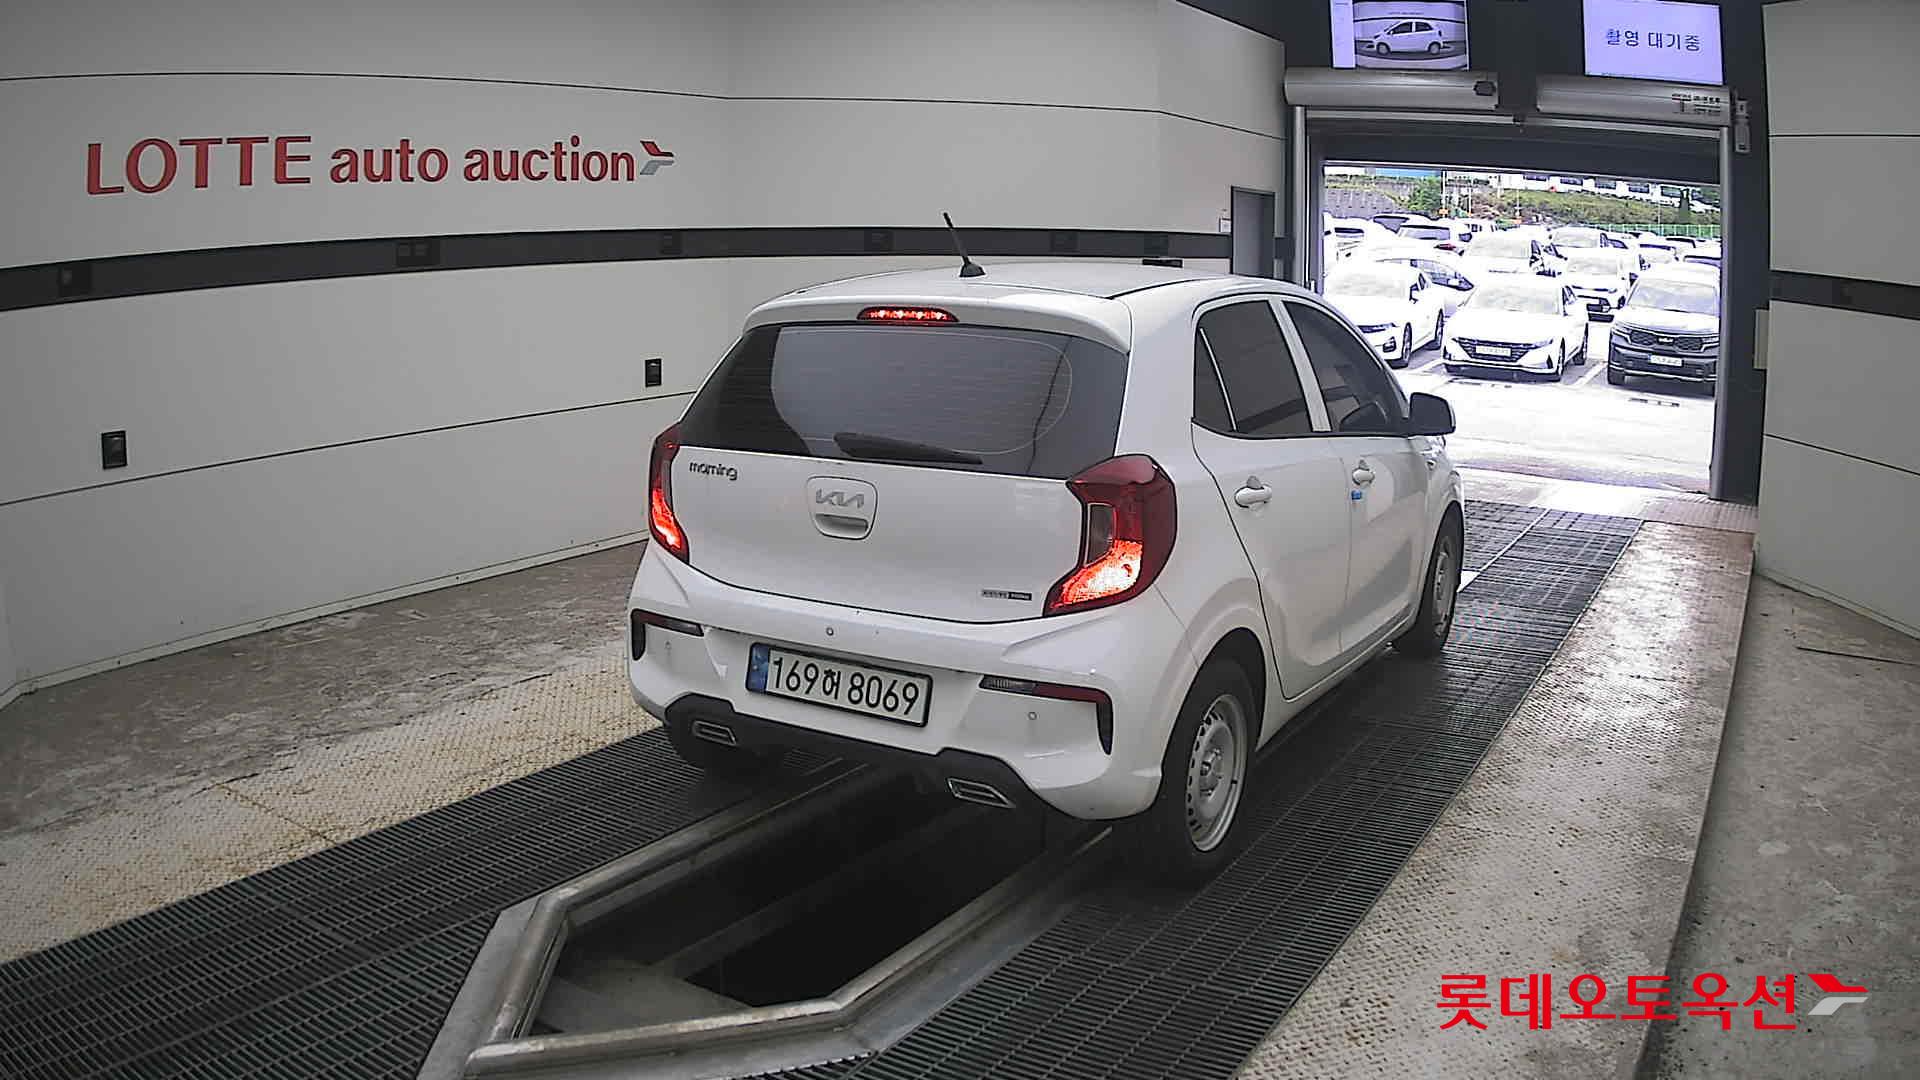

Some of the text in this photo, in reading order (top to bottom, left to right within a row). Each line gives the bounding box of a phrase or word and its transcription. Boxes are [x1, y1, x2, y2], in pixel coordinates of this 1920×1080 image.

[1647, 31, 1700, 51] 대기중
[87, 135, 636, 195] LOTTE auto auction
[689, 461, 738, 481] morning
[848, 671, 919, 715] 8069
